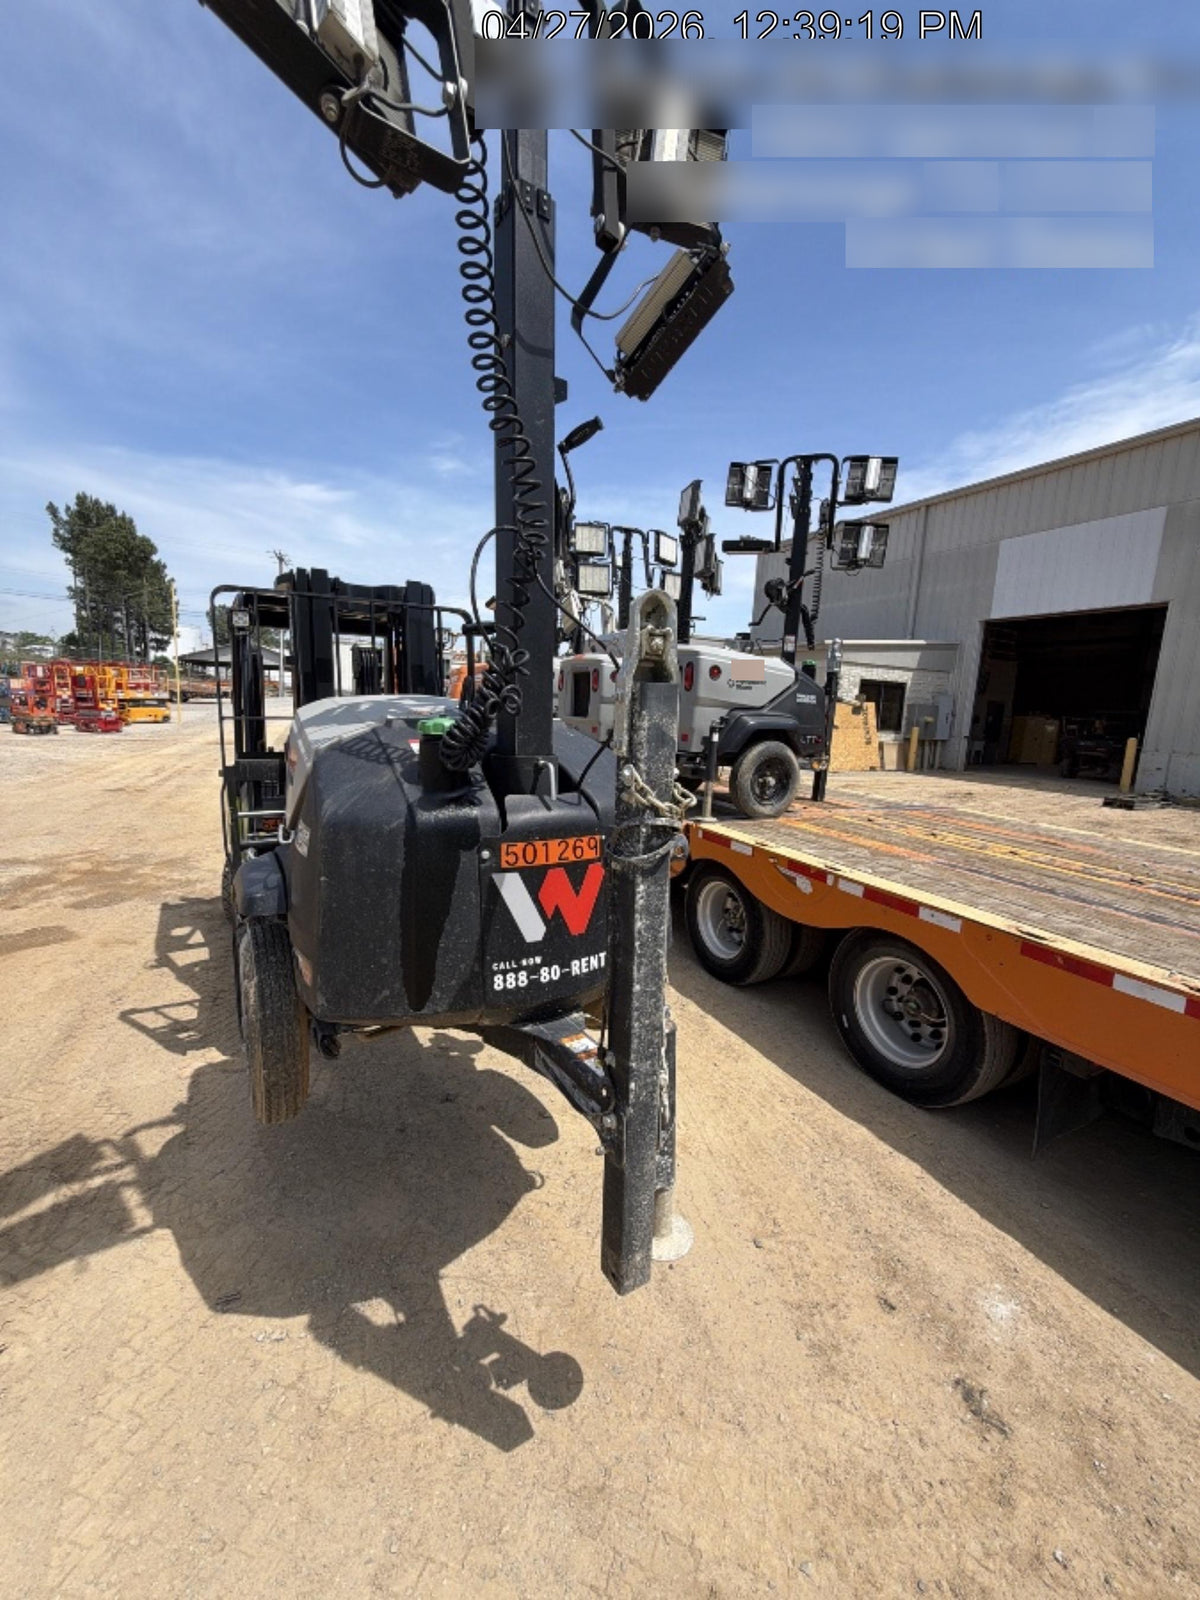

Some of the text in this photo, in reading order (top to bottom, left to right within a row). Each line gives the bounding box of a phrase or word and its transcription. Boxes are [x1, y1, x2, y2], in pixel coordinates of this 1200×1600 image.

[504, 836, 599, 866] 501269
[492, 960, 518, 971] CALL
[493, 951, 607, 991] 888-80-RENT
